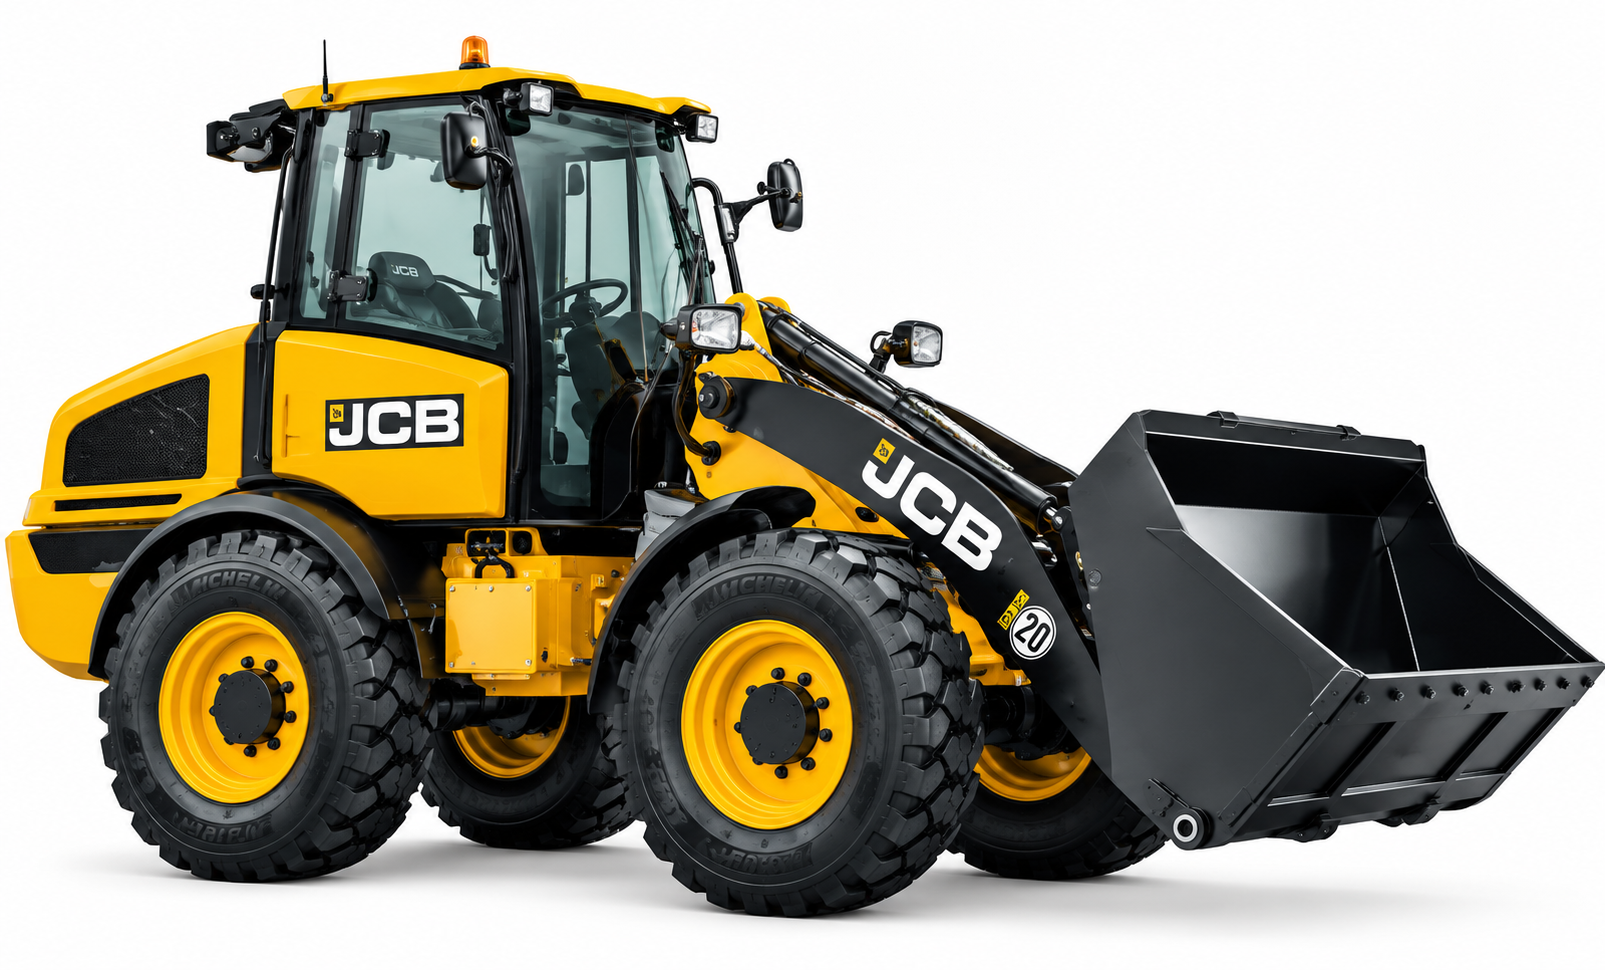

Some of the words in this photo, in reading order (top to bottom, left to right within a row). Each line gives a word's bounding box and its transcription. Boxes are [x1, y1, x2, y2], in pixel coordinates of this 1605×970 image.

[391, 265, 419, 277] JCB
[329, 399, 460, 447] JCB
[862, 455, 1003, 571] JCB
[1014, 612, 1051, 653] 20
